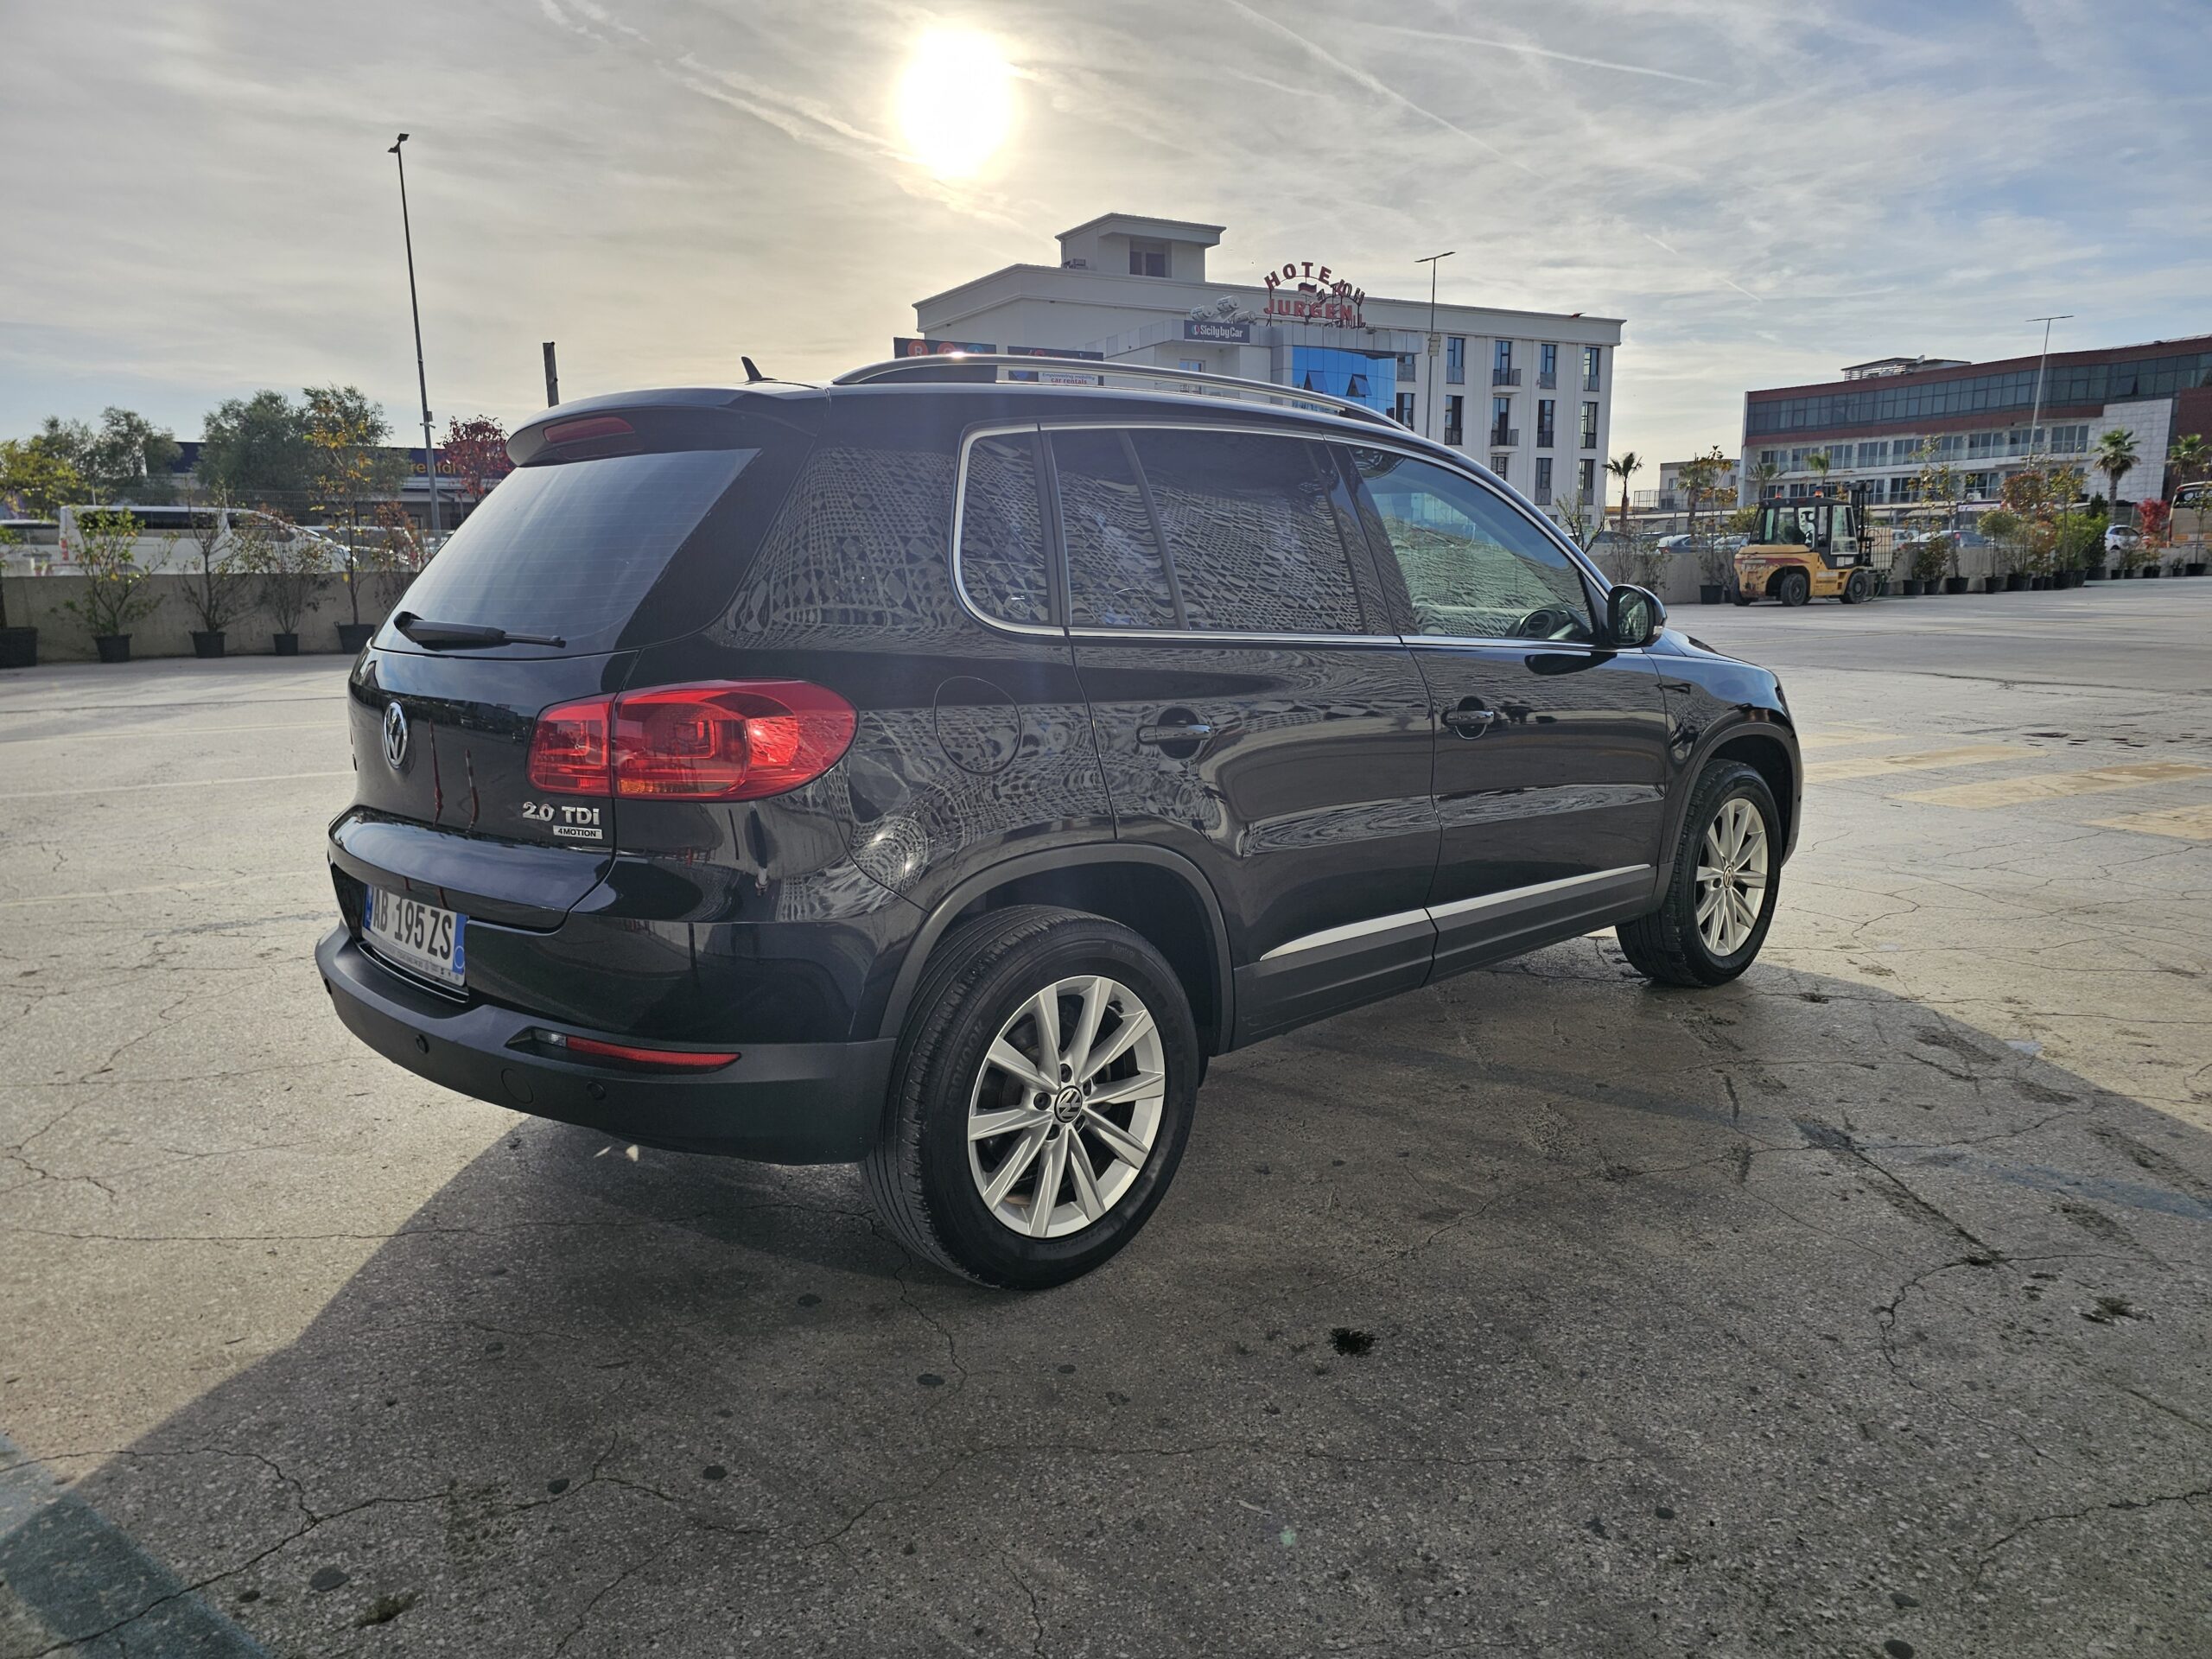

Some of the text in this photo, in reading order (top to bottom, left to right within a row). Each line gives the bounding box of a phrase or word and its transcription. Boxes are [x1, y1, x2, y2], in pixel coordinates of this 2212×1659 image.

[1264, 261, 1345, 297] HOTEL
[1263, 299, 1353, 321] JURGEN
[1200, 325, 1243, 338] Sicily by Car
[410, 461, 456, 474] retal
[557, 828, 596, 837] 4MOTION
